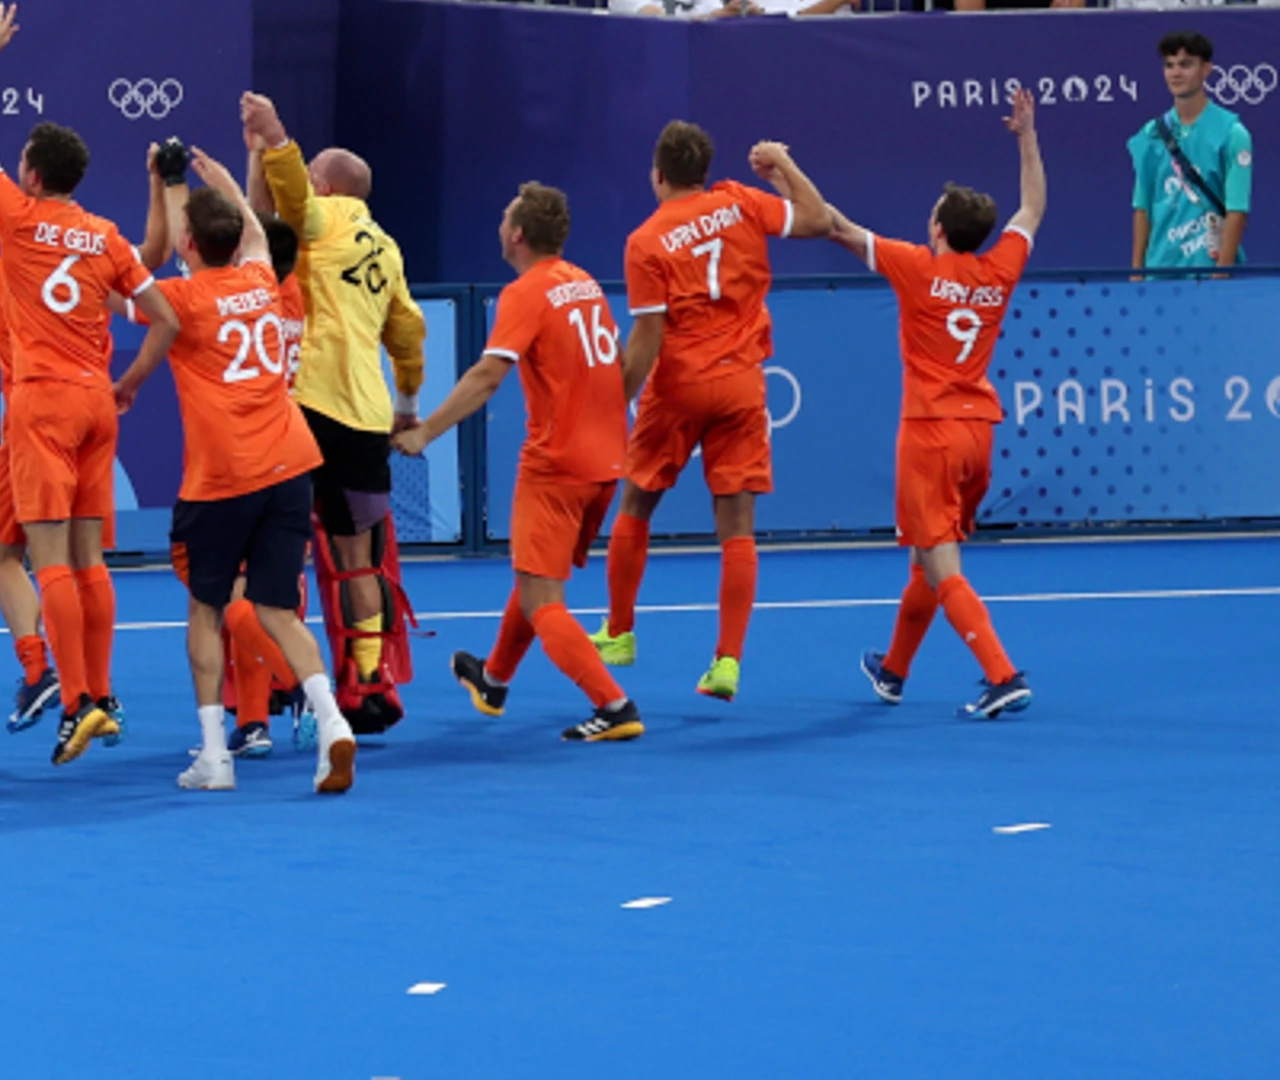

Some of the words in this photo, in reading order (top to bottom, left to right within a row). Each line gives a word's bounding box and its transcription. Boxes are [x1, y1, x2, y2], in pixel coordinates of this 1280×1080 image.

[912, 77, 1022, 109] PARIS
[1038, 74, 1138, 103] 2024
[33, 222, 62, 249] DE
[62, 228, 108, 257] GEUS
[690, 237, 724, 300] 7
[40, 253, 84, 316] 6
[217, 312, 286, 384] 20
[568, 304, 619, 369] 16
[945, 308, 983, 365] 9
[1013, 376, 1196, 426] PARIS
